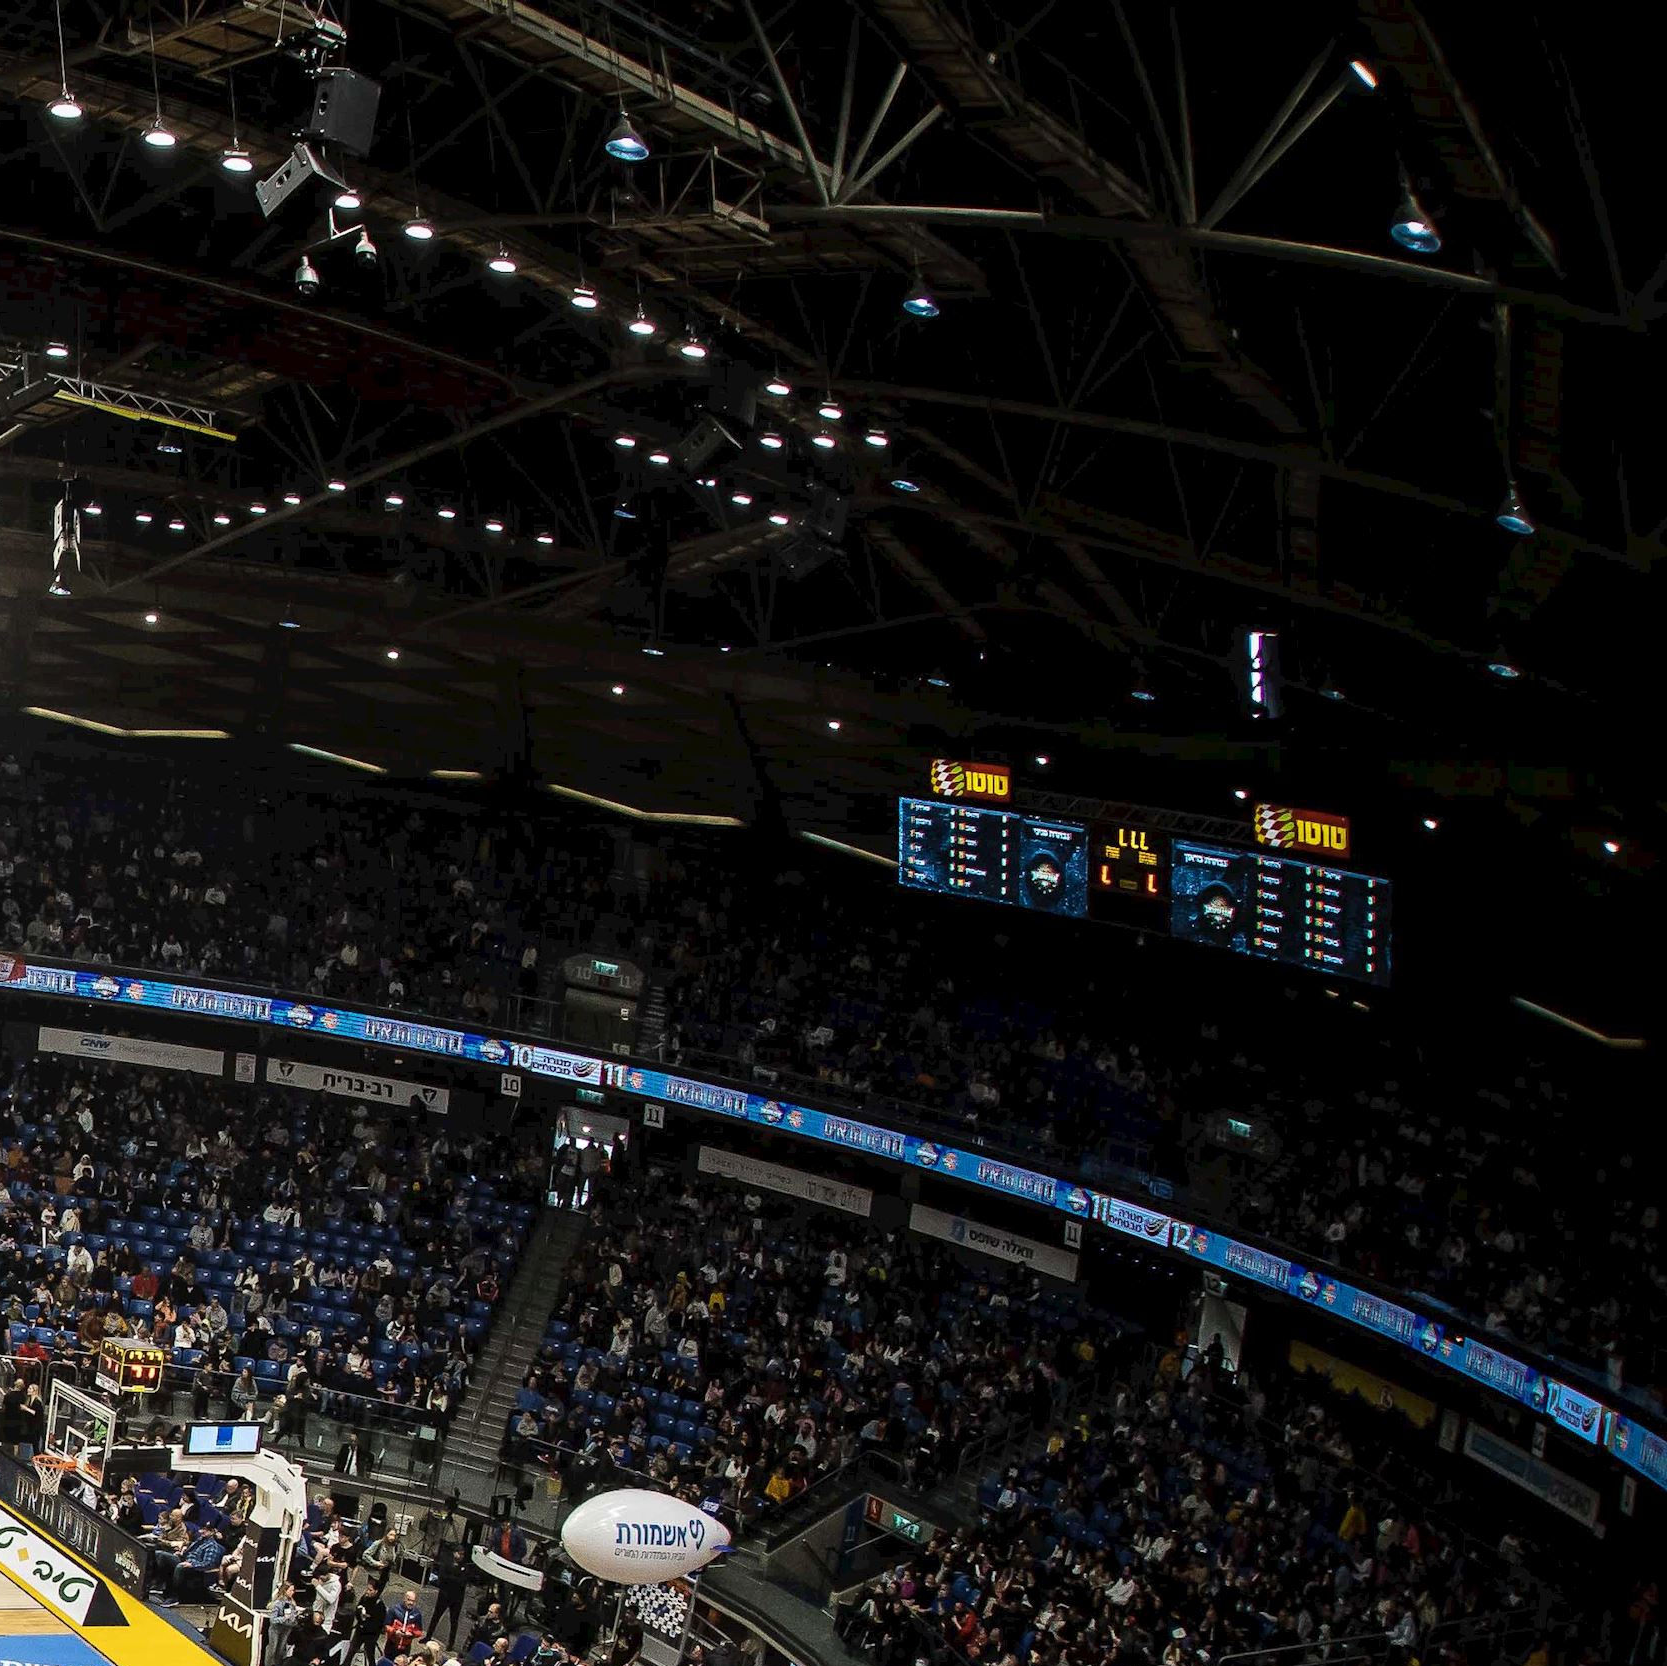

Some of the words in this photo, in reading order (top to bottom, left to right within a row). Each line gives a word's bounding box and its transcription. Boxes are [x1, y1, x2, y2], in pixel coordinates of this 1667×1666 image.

[966, 771, 1009, 795] טוטו
[1297, 819, 1348, 850] טוטו
[511, 1043, 535, 1068] 10
[504, 1077, 519, 1092] 10
[605, 1064, 626, 1088] 11
[1092, 1194, 1108, 1222] 11
[1171, 1221, 1192, 1251] 12
[616, 1523, 687, 1548] אשמורת
[32, 1560, 95, 1603] טיב
[218, 1606, 253, 1639] KIA
